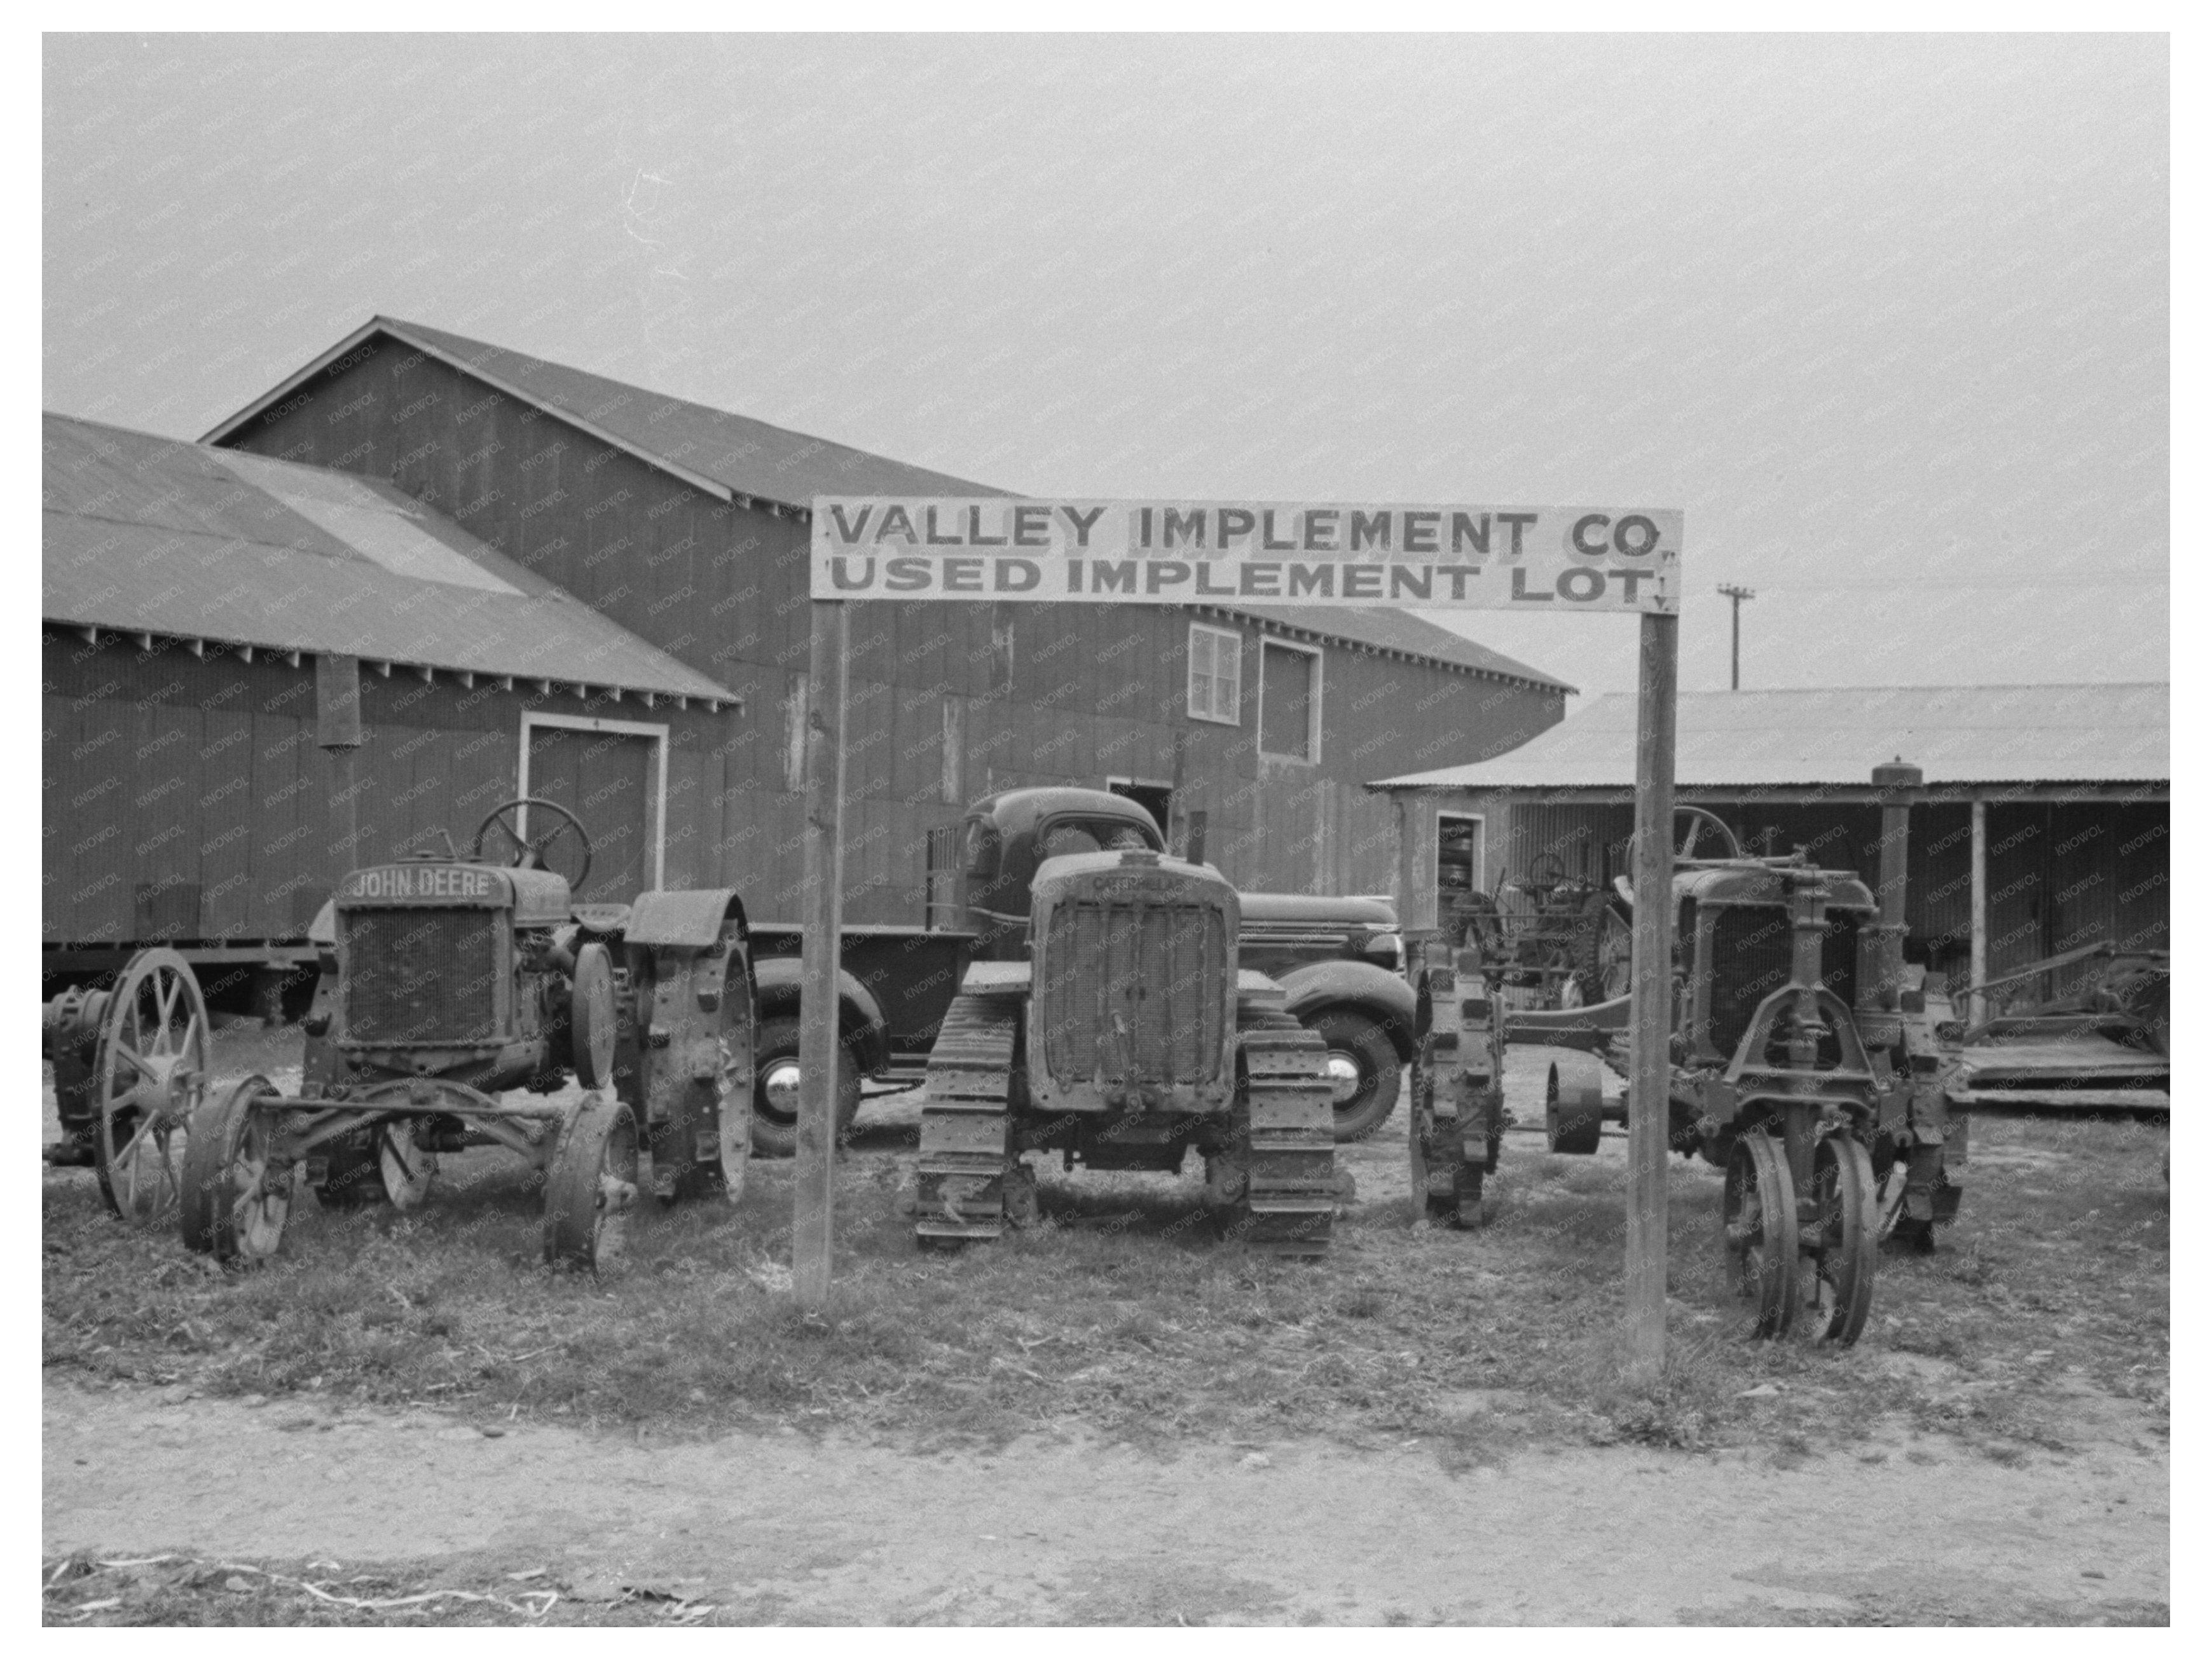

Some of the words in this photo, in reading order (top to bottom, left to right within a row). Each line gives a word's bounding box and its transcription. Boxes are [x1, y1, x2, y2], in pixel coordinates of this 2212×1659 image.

[830, 504, 1108, 547] VALLEY
[1141, 507, 1538, 555] IMPLEMENT
[832, 556, 1041, 592] USED
[1067, 559, 1481, 600] IMPLEMENT
[352, 869, 412, 897] JOHN
[419, 868, 490, 896] DEERE
